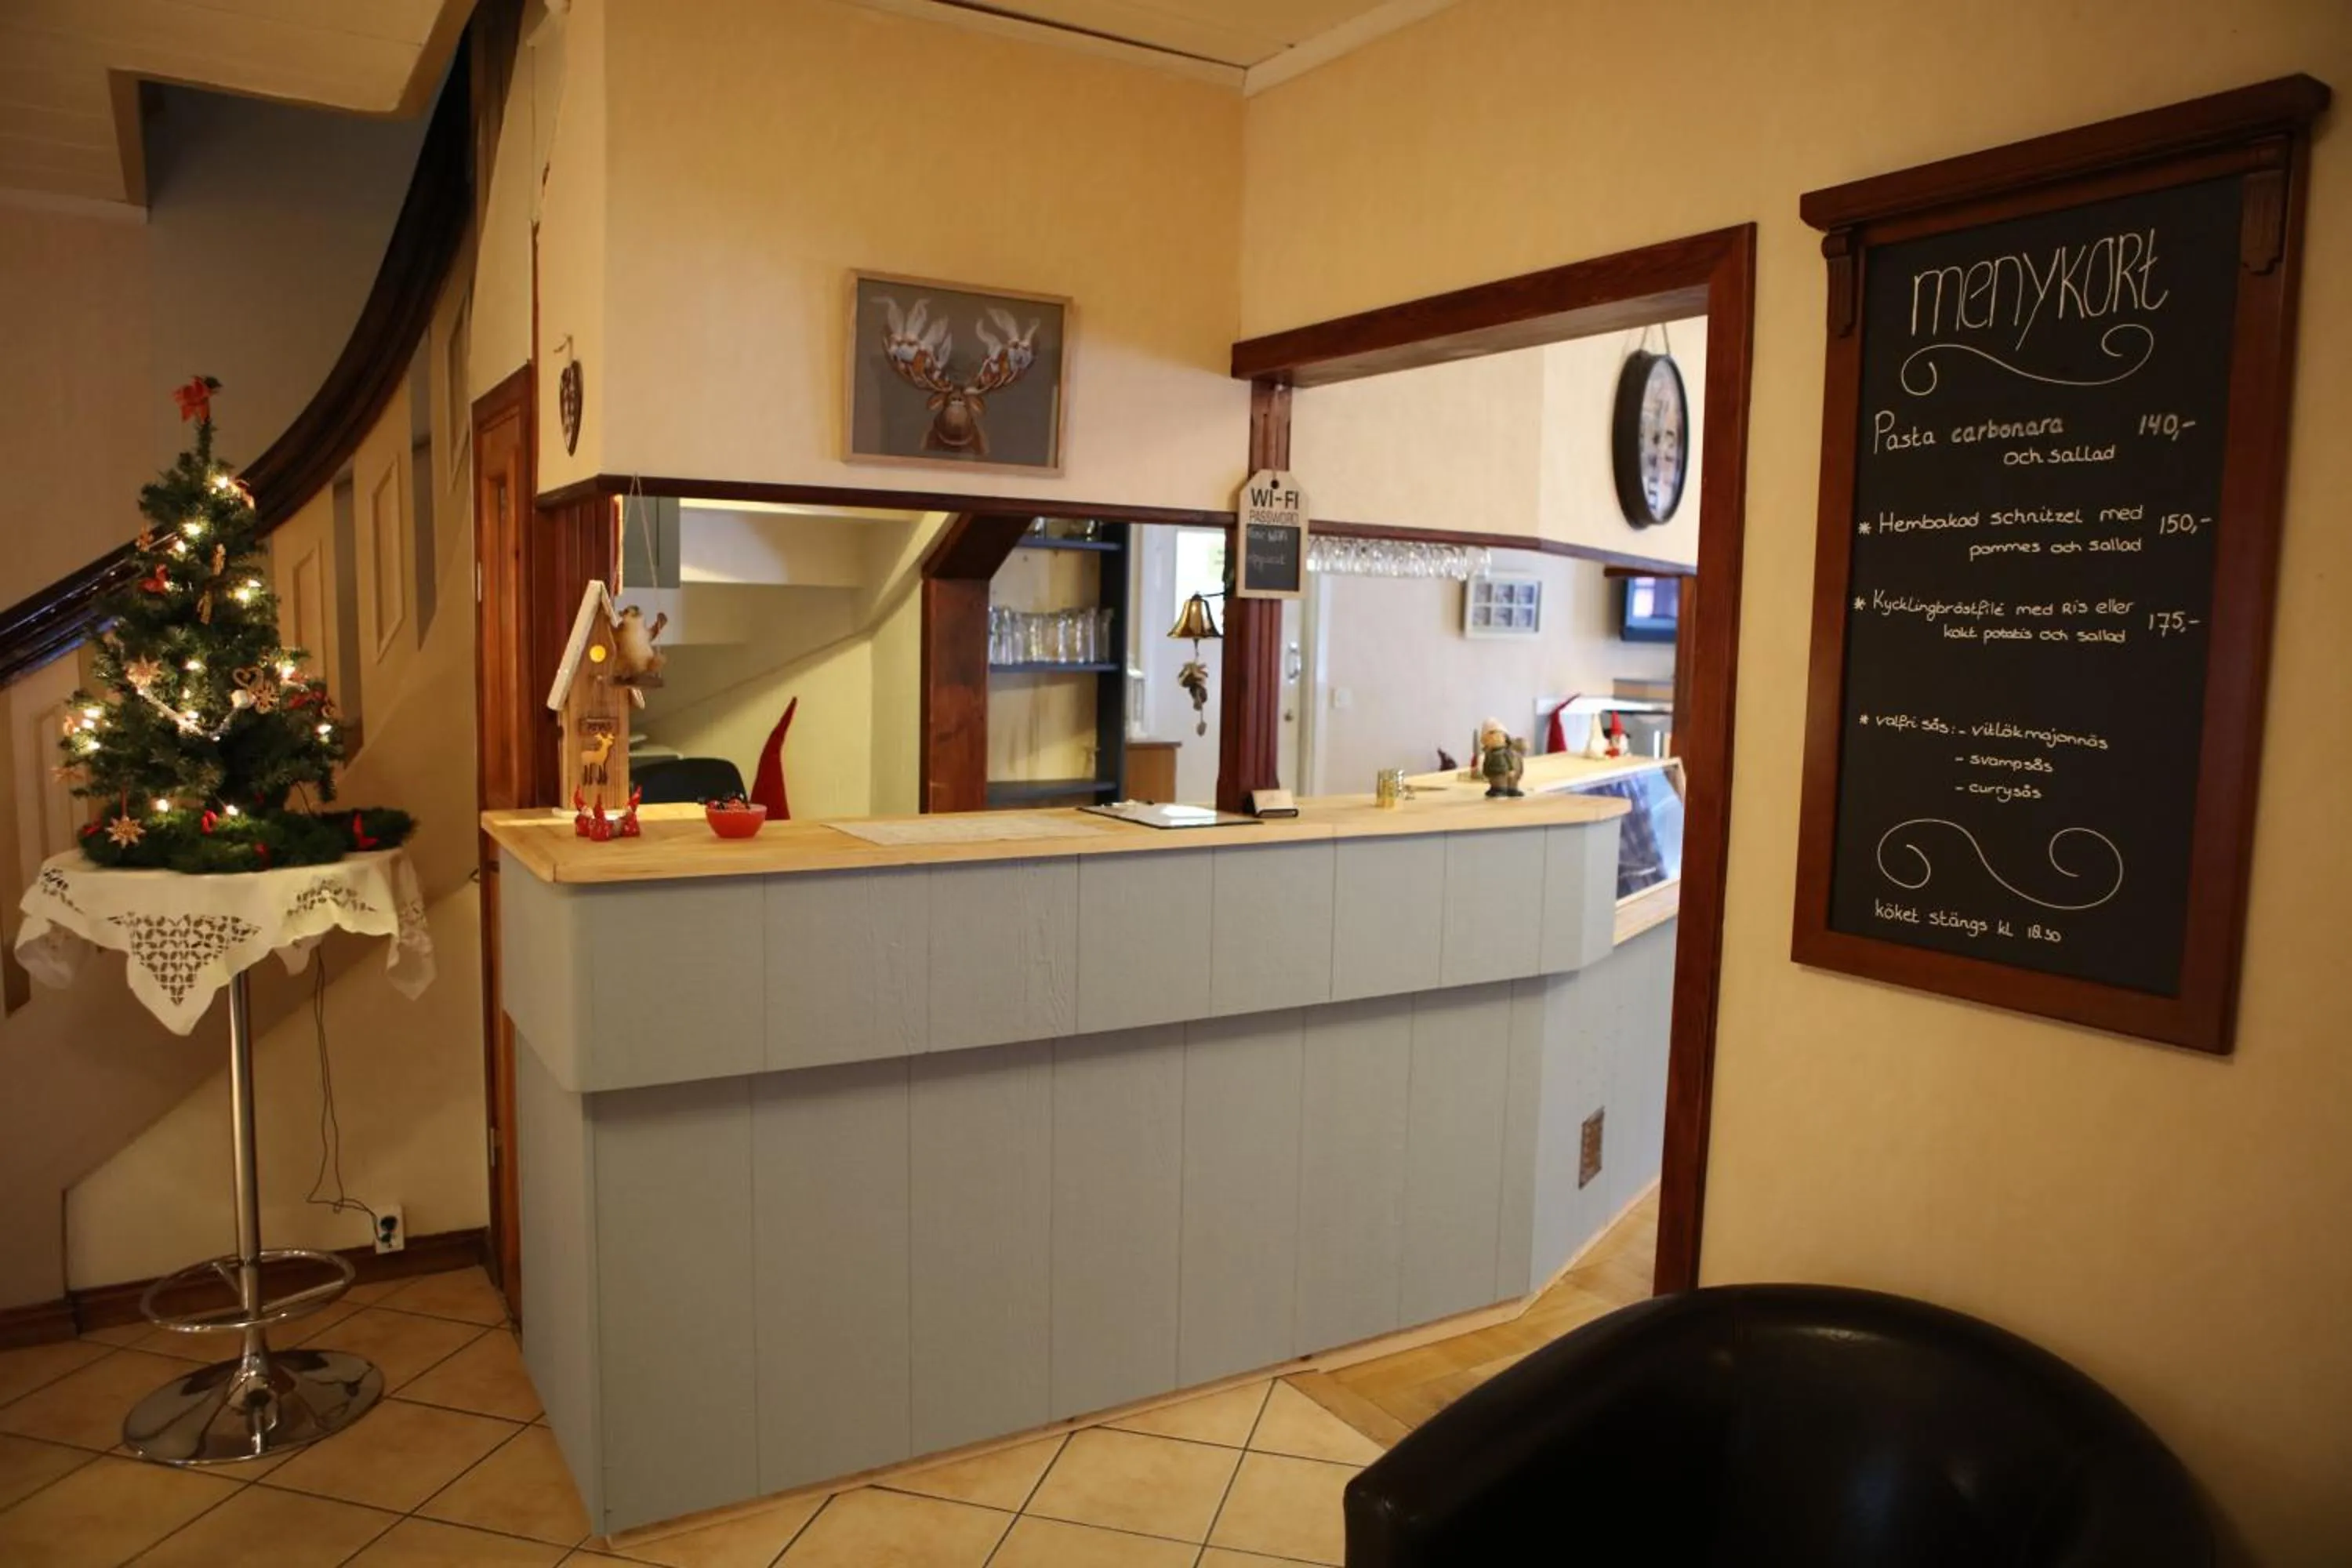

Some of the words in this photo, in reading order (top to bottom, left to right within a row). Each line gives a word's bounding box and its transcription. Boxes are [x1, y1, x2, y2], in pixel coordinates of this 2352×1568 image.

[1874, 409, 1936, 455] Pasta
[1951, 417, 2064, 444] carbonara
[2003, 447, 2044, 466] och
[2047, 445, 2116, 464] sallad
[1250, 488, 1300, 510] WI-FI
[1878, 511, 1980, 534] Hembakad
[1990, 506, 2083, 525] schnitzel
[2099, 504, 2143, 522] med
[1969, 542, 2042, 562] pommes
[2049, 540, 2082, 554] och
[2088, 537, 2142, 553] sallad
[2016, 600, 2054, 616] med
[2095, 598, 2133, 615] eller
[1944, 623, 1978, 639] kokt
[1983, 627, 2033, 644] potatis
[2039, 629, 2069, 641] och
[2076, 629, 2126, 644] sallad
[1875, 714, 1918, 732] valfri
[1969, 754, 2053, 773] svampsås
[1969, 783, 2042, 804] currysås
[1875, 898, 1920, 924] köket
[1929, 909, 1988, 938] stängs
[1996, 920, 2014, 937] kl
